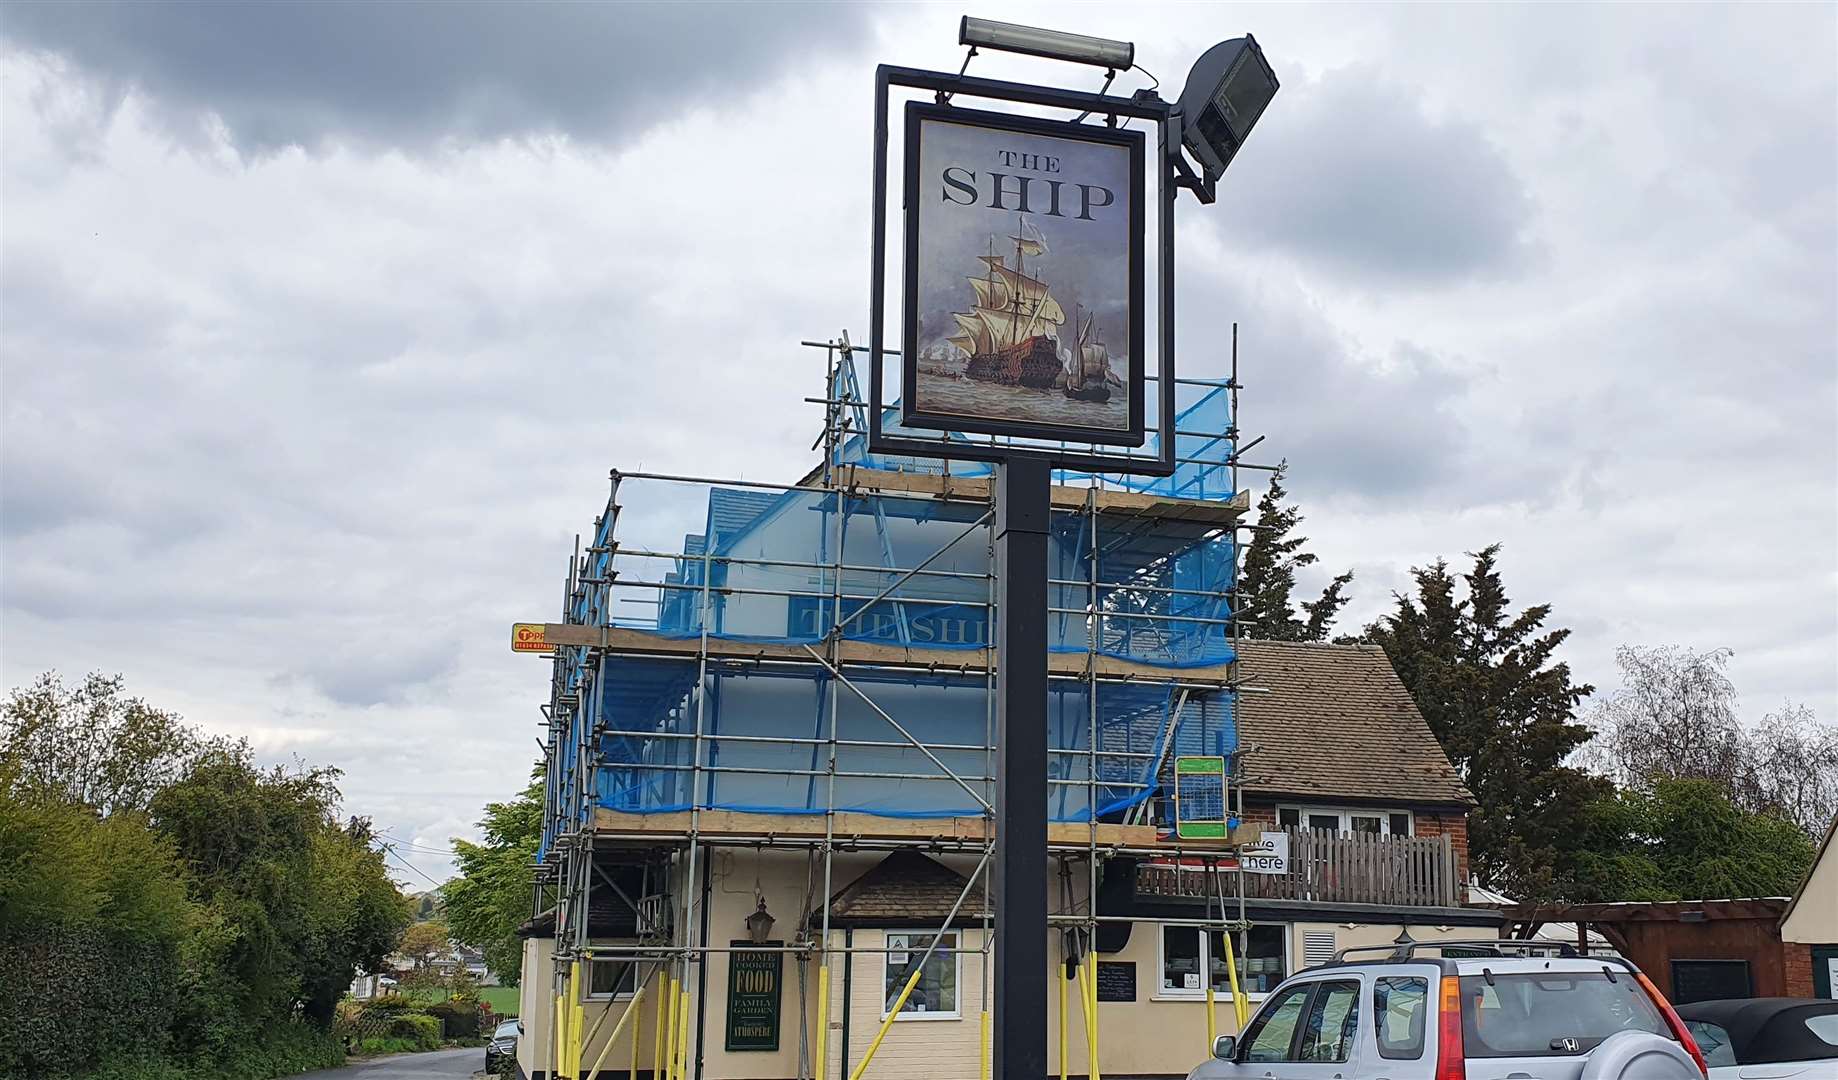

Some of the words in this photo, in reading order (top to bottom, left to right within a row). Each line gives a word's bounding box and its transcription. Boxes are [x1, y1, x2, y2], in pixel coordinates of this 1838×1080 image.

[999, 150, 1060, 173] THE
[942, 167, 1115, 221] SHIP
[801, 609, 895, 639] THE
[911, 615, 992, 644] SHI
[737, 953, 776, 961] HOME
[736, 970, 774, 992] FOOD
[735, 999, 771, 1007] FAMILY
